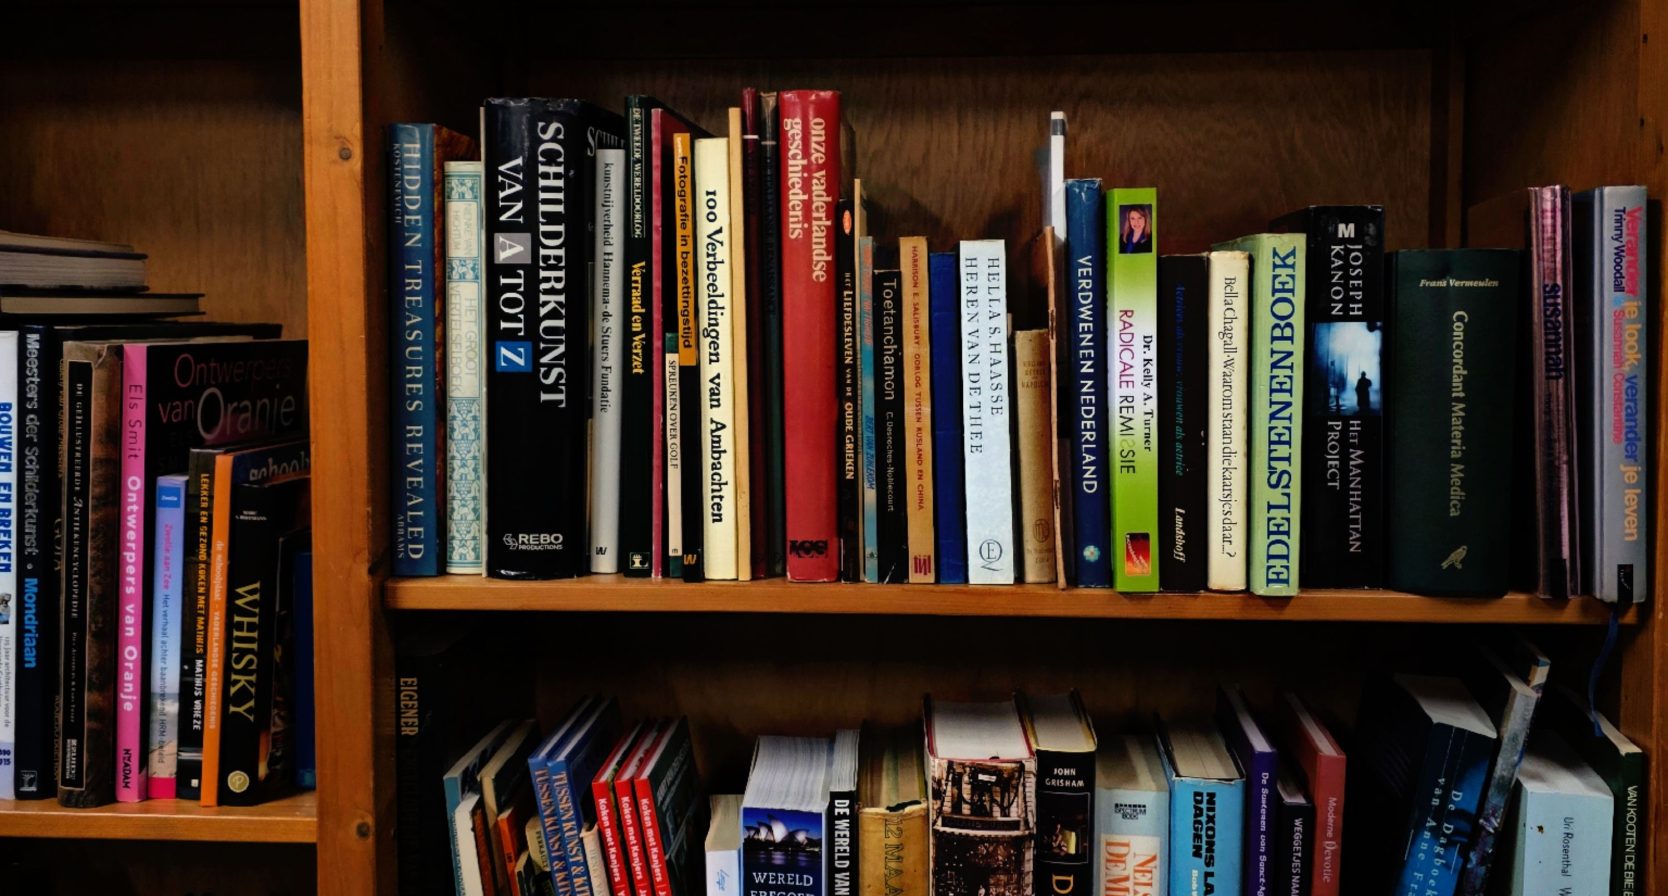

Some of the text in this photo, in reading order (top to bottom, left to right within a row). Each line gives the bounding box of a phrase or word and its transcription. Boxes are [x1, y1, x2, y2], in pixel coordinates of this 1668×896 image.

[632, 107, 643, 238] DE TWEEDE WERELDOORLOG
[783, 117, 809, 240] geschiedenis
[810, 117, 833, 283] onze vaderlandse
[498, 157, 526, 367] VAN A TOT Z
[537, 121, 566, 408] SCHILDERKUNST
[676, 156, 694, 348] Fotografie in bezettingstijd
[1337, 222, 1355, 239] M
[1346, 243, 1364, 316] JOSEPH
[600, 162, 615, 414] kunstnijverheid Hannema-de Stuers Fundatie
[631, 260, 647, 375] Verraad en Verzet
[987, 257, 1001, 321] HELLA
[1330, 244, 1346, 316] KANON
[1420, 278, 1499, 288] Frans Vermeulen
[1612, 206, 1626, 445] Trinny Woodall Susannah Constantine
[174, 352, 293, 389] Ontwerpers
[402, 142, 425, 560] HIDDEN TREASURES REVEALED
[702, 189, 728, 524] 100 Verbeeldingen van Ambachten
[843, 271, 856, 480] HET LIEFDESLEVEN VAN DE OUDE GRIEKEN
[882, 278, 899, 400] Toetanchamon
[911, 245, 925, 511] HARRISON SALISBURY OORLOG TUSSEN RUSLAND EN CHINA
[965, 257, 984, 454] HEREN VAN DE THEE
[989, 342, 1004, 416] HAASSE
[1077, 255, 1099, 494] VERDWENEN NEDERLAND
[1542, 282, 1566, 380] susannah
[1619, 205, 1644, 542] Verander je look, verander je leven
[158, 382, 297, 441] van Oranje
[668, 359, 680, 469] SPREUKEN OVER GOLF
[1119, 309, 1136, 475] RADICALE REMISSIE
[1140, 335, 1154, 452] Dr. Kelly A. Turner
[1218, 276, 1238, 516] Bella Waarom staan die kaarsjes
[1265, 246, 1297, 588] EDELSTENENBOEK
[1449, 309, 1469, 518] Concordant Materia Medica
[0, 402, 12, 573] BOUWEN EN BREKEN
[22, 332, 41, 670] Meesters der Schilderkunst Mondriaan
[1173, 507, 1188, 563] Landshoff
[120, 383, 144, 714] Els Smit Ontwerpers van Oranje
[397, 514, 405, 560] ABRAMS
[518, 533, 563, 544] REBO
[160, 594, 172, 664] Het verhaal achter
[192, 473, 211, 731] LEKKER EN GEZOND KOKEN MET MATHIJS MATHIJS VRIEZE
[229, 580, 262, 723] WHISKY
[400, 676, 420, 737] EIGENER
[1044, 778, 1086, 788] GRISHAM
[1052, 767, 1076, 776] JOHN
[1259, 772, 1270, 853] De Susteren van
[1417, 776, 1448, 862] van Anne
[1447, 789, 1464, 811] De
[599, 797, 624, 882] Koken met Kanjers
[620, 796, 648, 881] Koken met Kanjers
[640, 798, 666, 883] Koken met Kanjers
[834, 799, 850, 896] DE WERELD VAN
[884, 817, 903, 839] 12
[1191, 791, 1204, 859] DAGEN
[1204, 791, 1216, 868] NIXONS
[1291, 817, 1304, 874] WEGGETJES
[1322, 796, 1340, 884] Moderne Devotie
[1560, 816, 1576, 878] Uri Rosenthal
[1623, 785, 1639, 889] VAN KOOTEN DE BIE
[752, 872, 814, 888] WERELD
